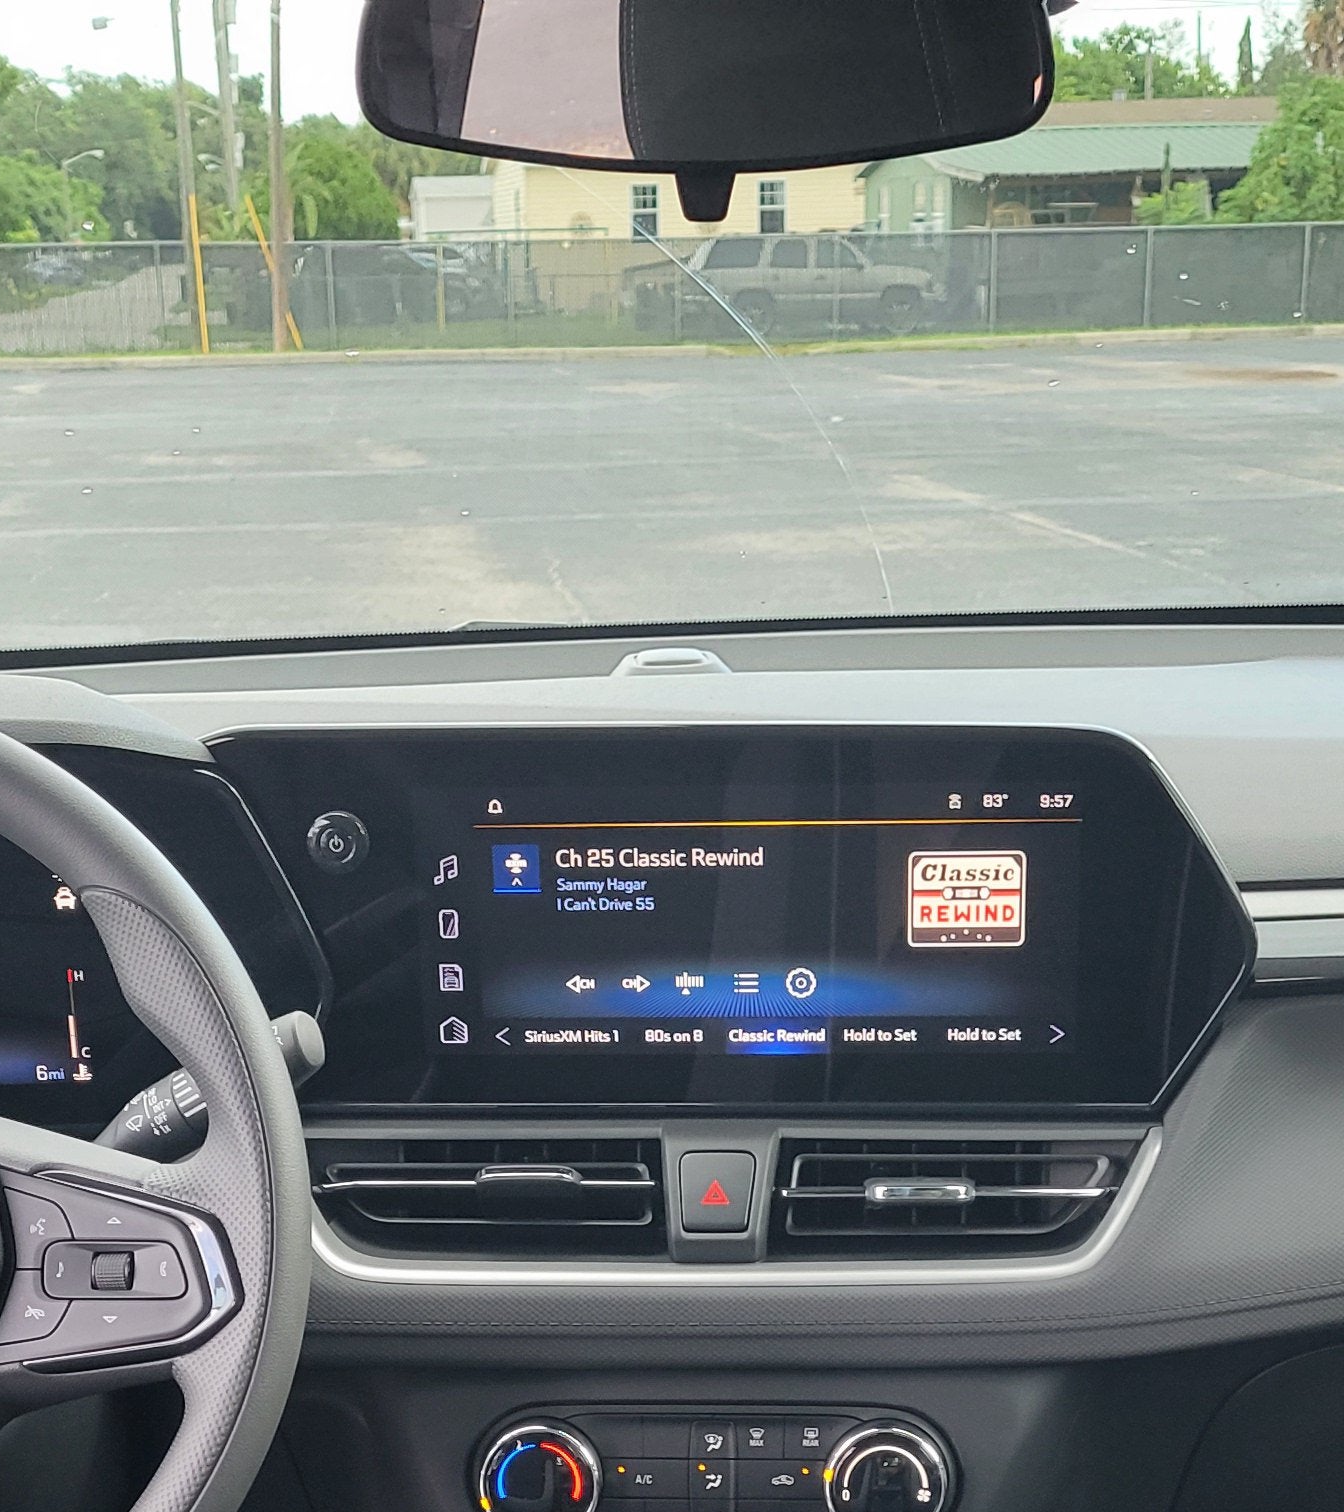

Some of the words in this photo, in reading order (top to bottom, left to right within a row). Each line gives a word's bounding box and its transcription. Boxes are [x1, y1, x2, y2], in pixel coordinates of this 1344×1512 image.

[1039, 794, 1074, 808] 9:57
[555, 848, 583, 868] Ch
[586, 848, 615, 868] 25
[618, 847, 687, 868] Classic
[691, 846, 764, 867] Rewind
[921, 864, 1015, 882] Classic
[556, 877, 606, 894] Sammy
[607, 878, 647, 894] Hagar
[557, 898, 561, 911] I
[564, 897, 597, 911] Can't
[599, 897, 634, 911] Drive
[635, 896, 655, 911] 55
[920, 904, 1015, 922] REWIND
[73, 970, 84, 981] H
[524, 1030, 582, 1043] SiriusXM
[584, 1030, 611, 1043] Hits
[612, 1030, 619, 1042] 1
[645, 1029, 672, 1042] 80s
[673, 1032, 691, 1042] on
[693, 1029, 704, 1042] 8
[728, 1028, 775, 1042] Classic
[777, 1028, 826, 1042] Rewind
[843, 1028, 877, 1042] Hold
[878, 1029, 892, 1042] to
[894, 1028, 917, 1042] Set
[947, 1028, 980, 1041] Hold
[981, 1029, 996, 1041] to
[998, 1028, 1022, 1041] Set
[81, 1046, 92, 1058] C
[749, 1439, 765, 1447] MAX
[635, 1474, 653, 1485] A/C
[841, 1489, 851, 1501] 0
